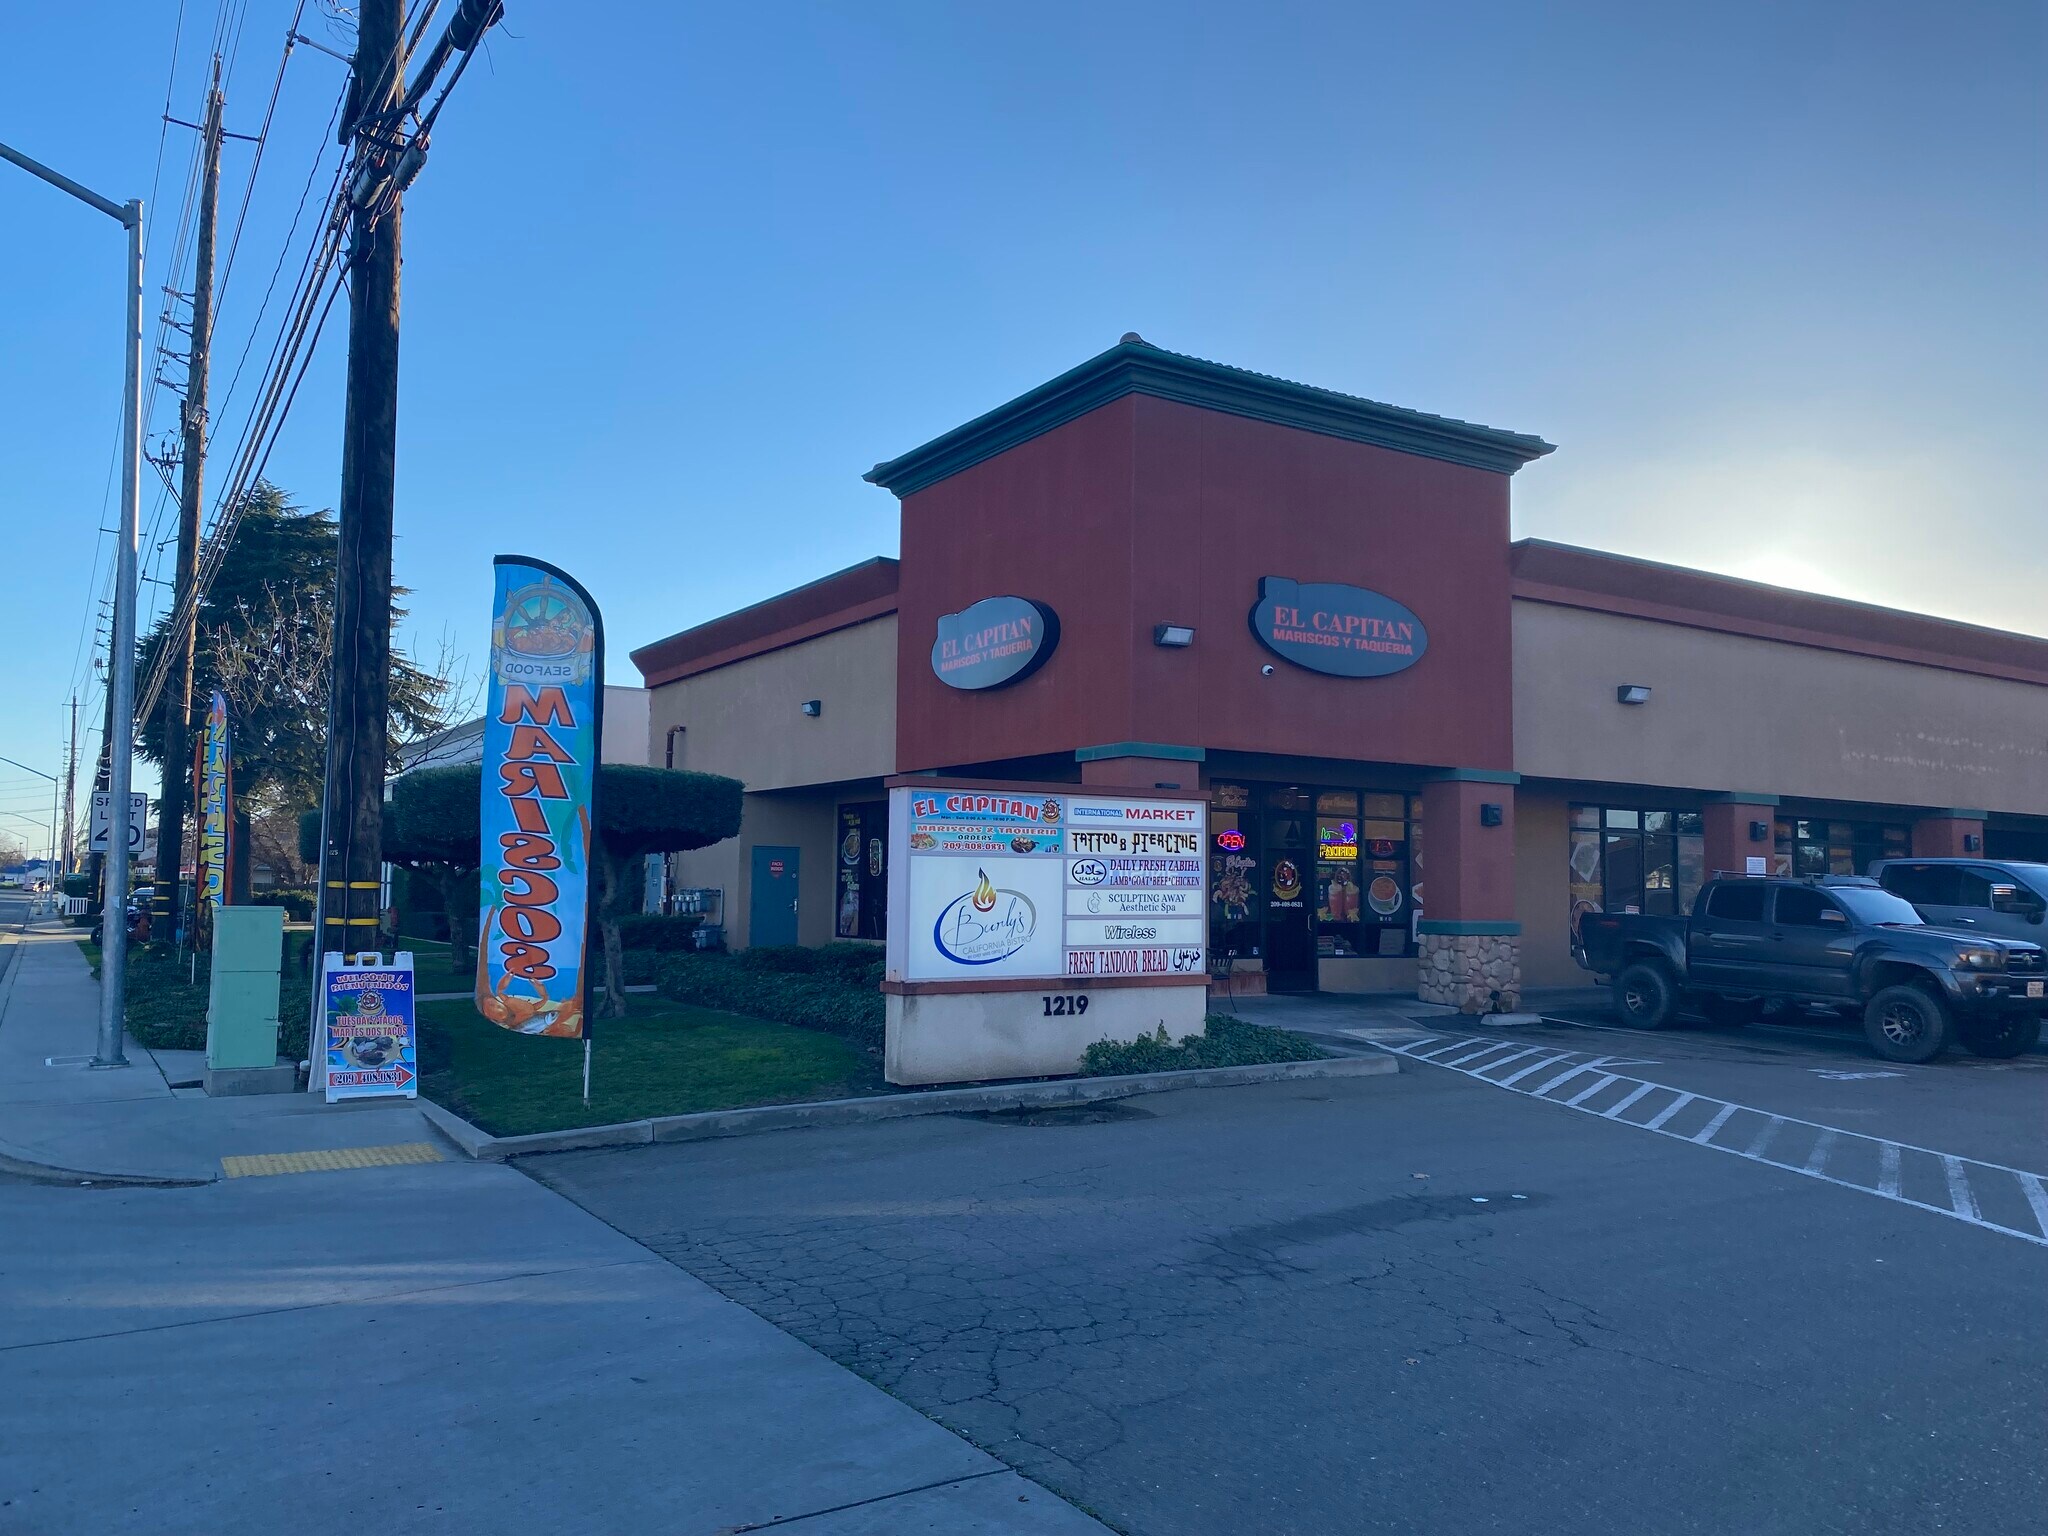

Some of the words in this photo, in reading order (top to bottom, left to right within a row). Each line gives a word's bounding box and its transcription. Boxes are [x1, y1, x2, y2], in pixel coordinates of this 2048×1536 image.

[1274, 606, 1305, 628] EL
[1313, 612, 1413, 641] CAPITAN
[942, 640, 961, 659] EL
[964, 616, 1032, 652] CAPITAN
[1273, 628, 1340, 648] MARISCOS
[1343, 637, 1352, 649] Y
[1354, 638, 1414, 656] TAQUERIA
[941, 654, 981, 673] MARISCOS
[982, 651, 989, 662] Y
[990, 639, 1033, 659] TAQUERIA
[96, 797, 143, 807] SPD
[914, 799, 940, 818] EL
[946, 796, 1040, 822] CAPITAN
[1074, 808, 1123, 817] INTERNATIONAL
[1126, 809, 1195, 821] MARKET
[917, 825, 983, 834] MARISCOS
[999, 827, 1057, 835] TAQUERIA
[1071, 832, 1118, 853] TATTOO
[1132, 832, 1197, 854] PIERCING
[1217, 834, 1246, 848] OPEN
[1110, 859, 1136, 871] DAILY
[1139, 860, 1166, 871] FRESH
[1168, 860, 1200, 871] ZABIHA
[1108, 894, 1160, 903] SCULPTING
[1161, 894, 1186, 903] AWAY
[1120, 902, 1158, 912] Aesthetic
[1161, 903, 1176, 913] Spa
[1105, 925, 1156, 939] Wireless
[963, 939, 1005, 955] CALIFORNIA
[1006, 934, 1032, 947] BISTRO
[1069, 952, 1095, 974] FRESH
[1100, 950, 1139, 974] TANDOOR
[1142, 949, 1168, 973] BREAD
[336, 973, 395, 983] WELCOME
[1042, 995, 1089, 1016] 1219
[380, 1015, 403, 1025] TACOS
[332, 1026, 364, 1037] MARTES
[366, 1026, 382, 1036] DOS
[384, 1025, 407, 1035] TACOS
